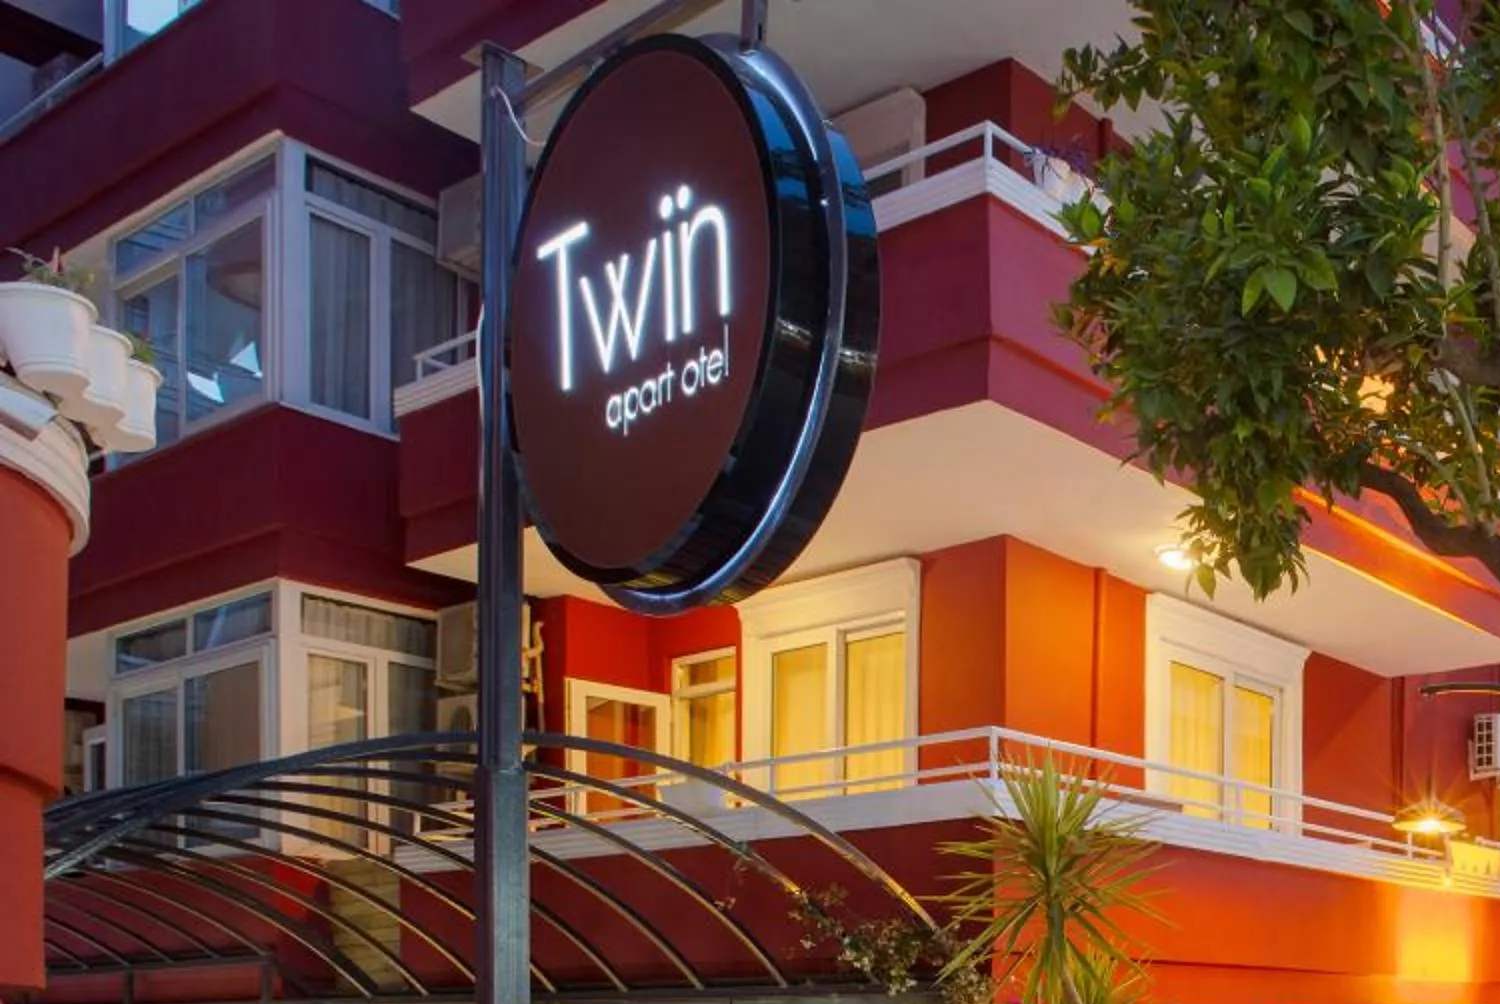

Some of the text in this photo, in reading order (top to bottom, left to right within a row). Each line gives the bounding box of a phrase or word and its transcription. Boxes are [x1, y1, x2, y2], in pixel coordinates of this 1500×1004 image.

[537, 184, 731, 392] Twin
[606, 322, 730, 437] apart otel
